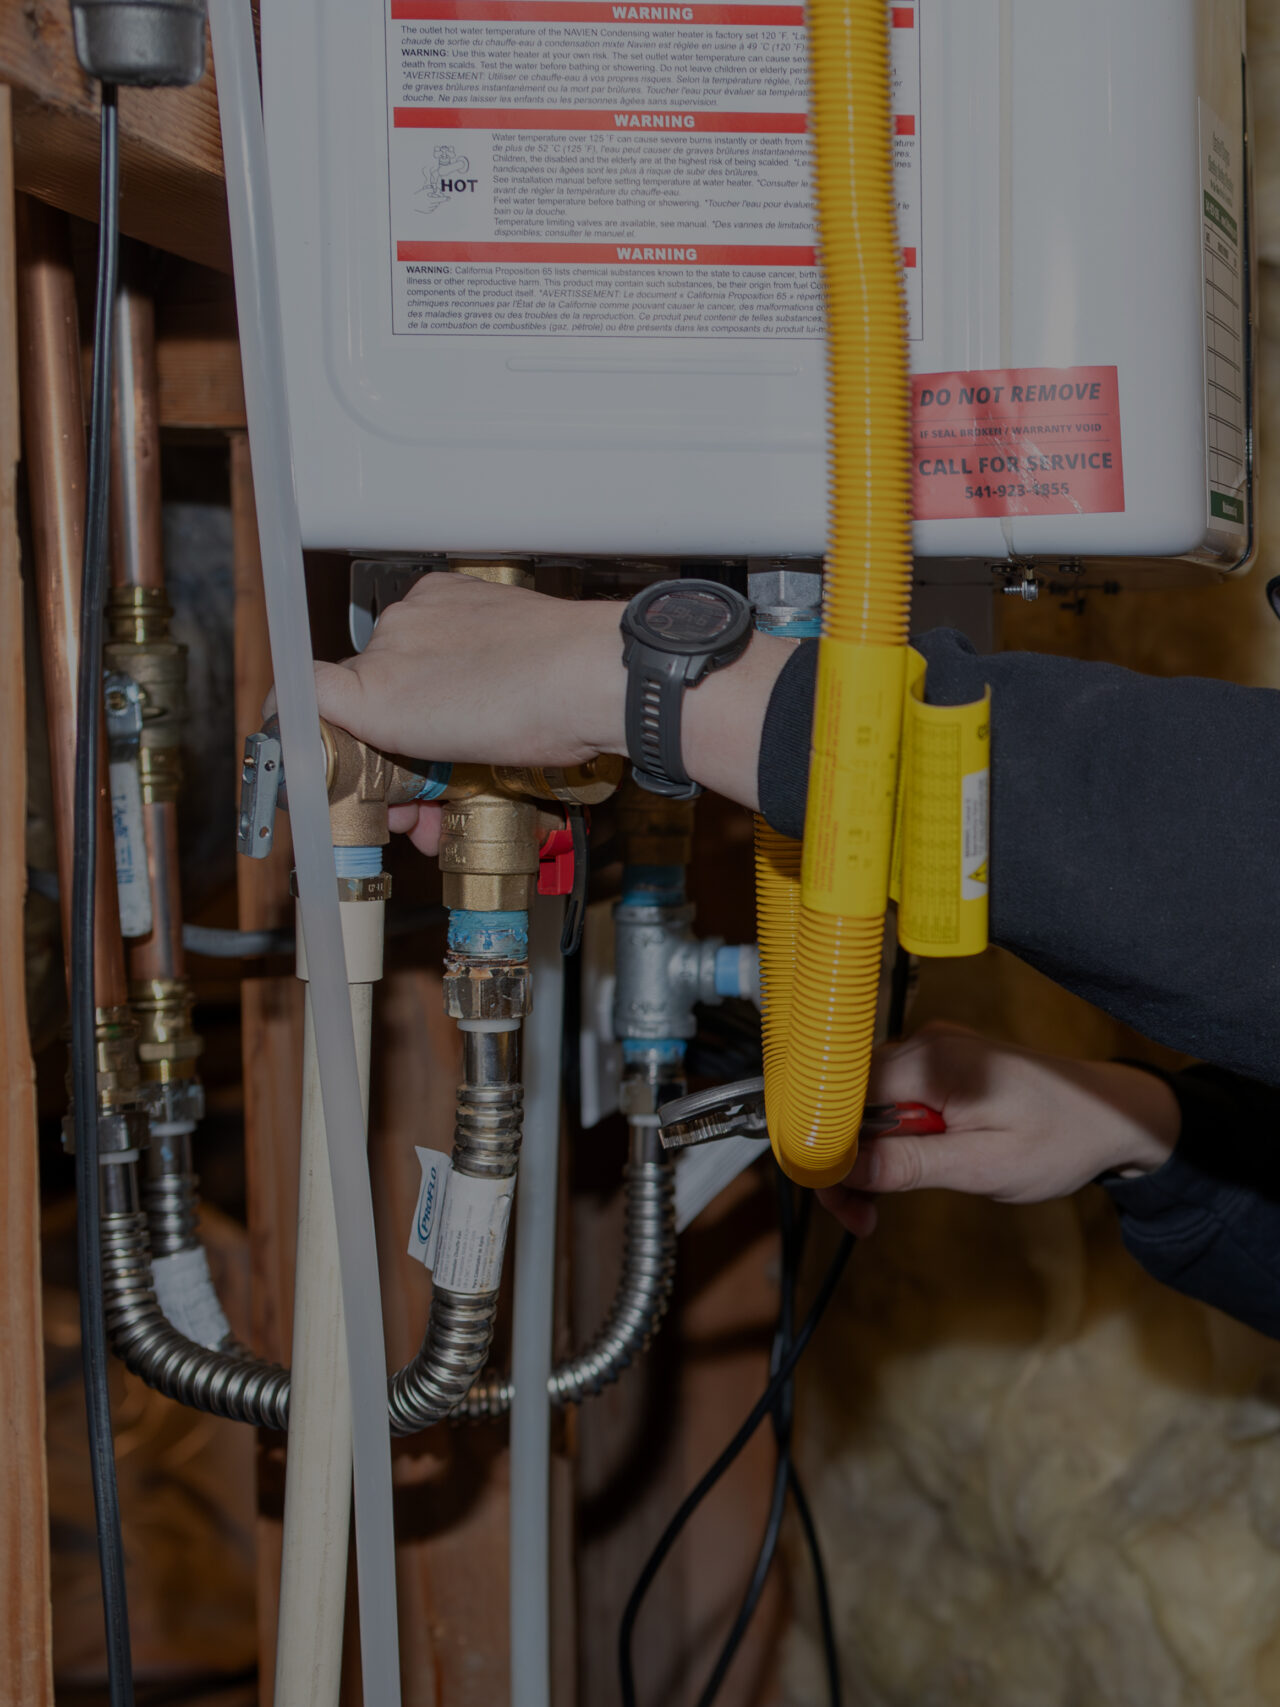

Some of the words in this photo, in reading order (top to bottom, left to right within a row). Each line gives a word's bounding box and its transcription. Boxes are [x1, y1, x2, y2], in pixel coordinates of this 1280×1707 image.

[612, 6, 693, 20] WARNING
[400, 24, 417, 33] The
[419, 24, 442, 34] outlet
[444, 24, 458, 34] hot
[460, 26, 483, 34] water
[485, 26, 535, 38] temperature
[538, 26, 546, 35] of
[548, 26, 562, 36] the
[564, 27, 598, 36] NAVIEN
[600, 27, 650, 40] Condensing
[652, 29, 675, 38] water
[677, 29, 704, 38] heater
[715, 30, 743, 42] factory
[745, 31, 758, 39] set
[452, 48, 468, 56] Use
[470, 48, 485, 57] this
[487, 48, 510, 57] water
[513, 48, 540, 58] heater
[542, 50, 550, 58] at
[552, 51, 570, 61] your
[612, 50, 628, 60] The
[630, 51, 643, 60] set
[645, 51, 668, 60] outlet
[670, 52, 693, 61] water
[696, 52, 746, 64] temperature
[401, 58, 425, 67] death
[480, 60, 497, 68] Test
[499, 60, 513, 69] the
[514, 60, 537, 69] water
[540, 60, 566, 70] before
[569, 61, 600, 73] bathing
[660, 63, 672, 72] Do
[674, 63, 687, 72] not
[690, 63, 712, 72] leave
[714, 64, 747, 73] children
[760, 64, 787, 76] elderly
[438, 92, 450, 101] Ne
[452, 94, 468, 104] pas
[470, 93, 498, 102] laisser
[499, 93, 512, 102] les
[514, 94, 545, 103] enfants
[560, 94, 572, 104] les
[573, 97, 618, 107] personnes
[620, 95, 645, 107] âgées
[614, 114, 695, 128] WARNING
[441, 179, 478, 192] HOT
[492, 174, 509, 183] See
[511, 174, 553, 184] installation
[555, 175, 584, 184] manual
[586, 175, 612, 185] before
[614, 176, 640, 188] setting
[642, 177, 691, 188] temperature
[693, 178, 701, 186] at
[702, 178, 725, 186] water
[493, 195, 511, 204] Feel
[513, 196, 535, 205] water
[537, 196, 586, 208] temperature
[588, 196, 614, 206] before
[616, 197, 646, 209] bathing
[742, 198, 761, 208] l'eau
[763, 201, 782, 210] pour
[494, 216, 544, 228] Temperature
[546, 217, 575, 229] limiting
[576, 217, 602, 227] valves
[660, 220, 675, 228] see
[765, 220, 775, 229] de
[616, 247, 697, 261] WARNING
[455, 265, 493, 274] California
[495, 265, 540, 277] Proposition
[554, 266, 570, 275] lists
[572, 266, 608, 276] chemical
[610, 266, 655, 276] substances
[658, 267, 684, 276] known
[696, 267, 708, 276] the
[710, 268, 730, 277] state
[406, 275, 432, 285] illness
[444, 276, 465, 285] other
[467, 276, 516, 288] reproductive
[614, 278, 644, 287] contain
[646, 278, 665, 287] such
[717, 278, 727, 288] be
[729, 279, 747, 288] their
[749, 279, 771, 290] origin
[919, 389, 950, 406] DO
[958, 386, 1004, 405] NOT
[1010, 382, 1101, 403] REMOVE
[920, 431, 929, 439] IF
[932, 429, 957, 439] SEAL
[960, 427, 1002, 438] BROKEN
[1012, 424, 1072, 435] WARRANTY
[1076, 423, 1102, 433] VOID
[918, 457, 973, 476] CALL
[979, 456, 1020, 474] FOR
[1026, 452, 1113, 472] SERVICE
